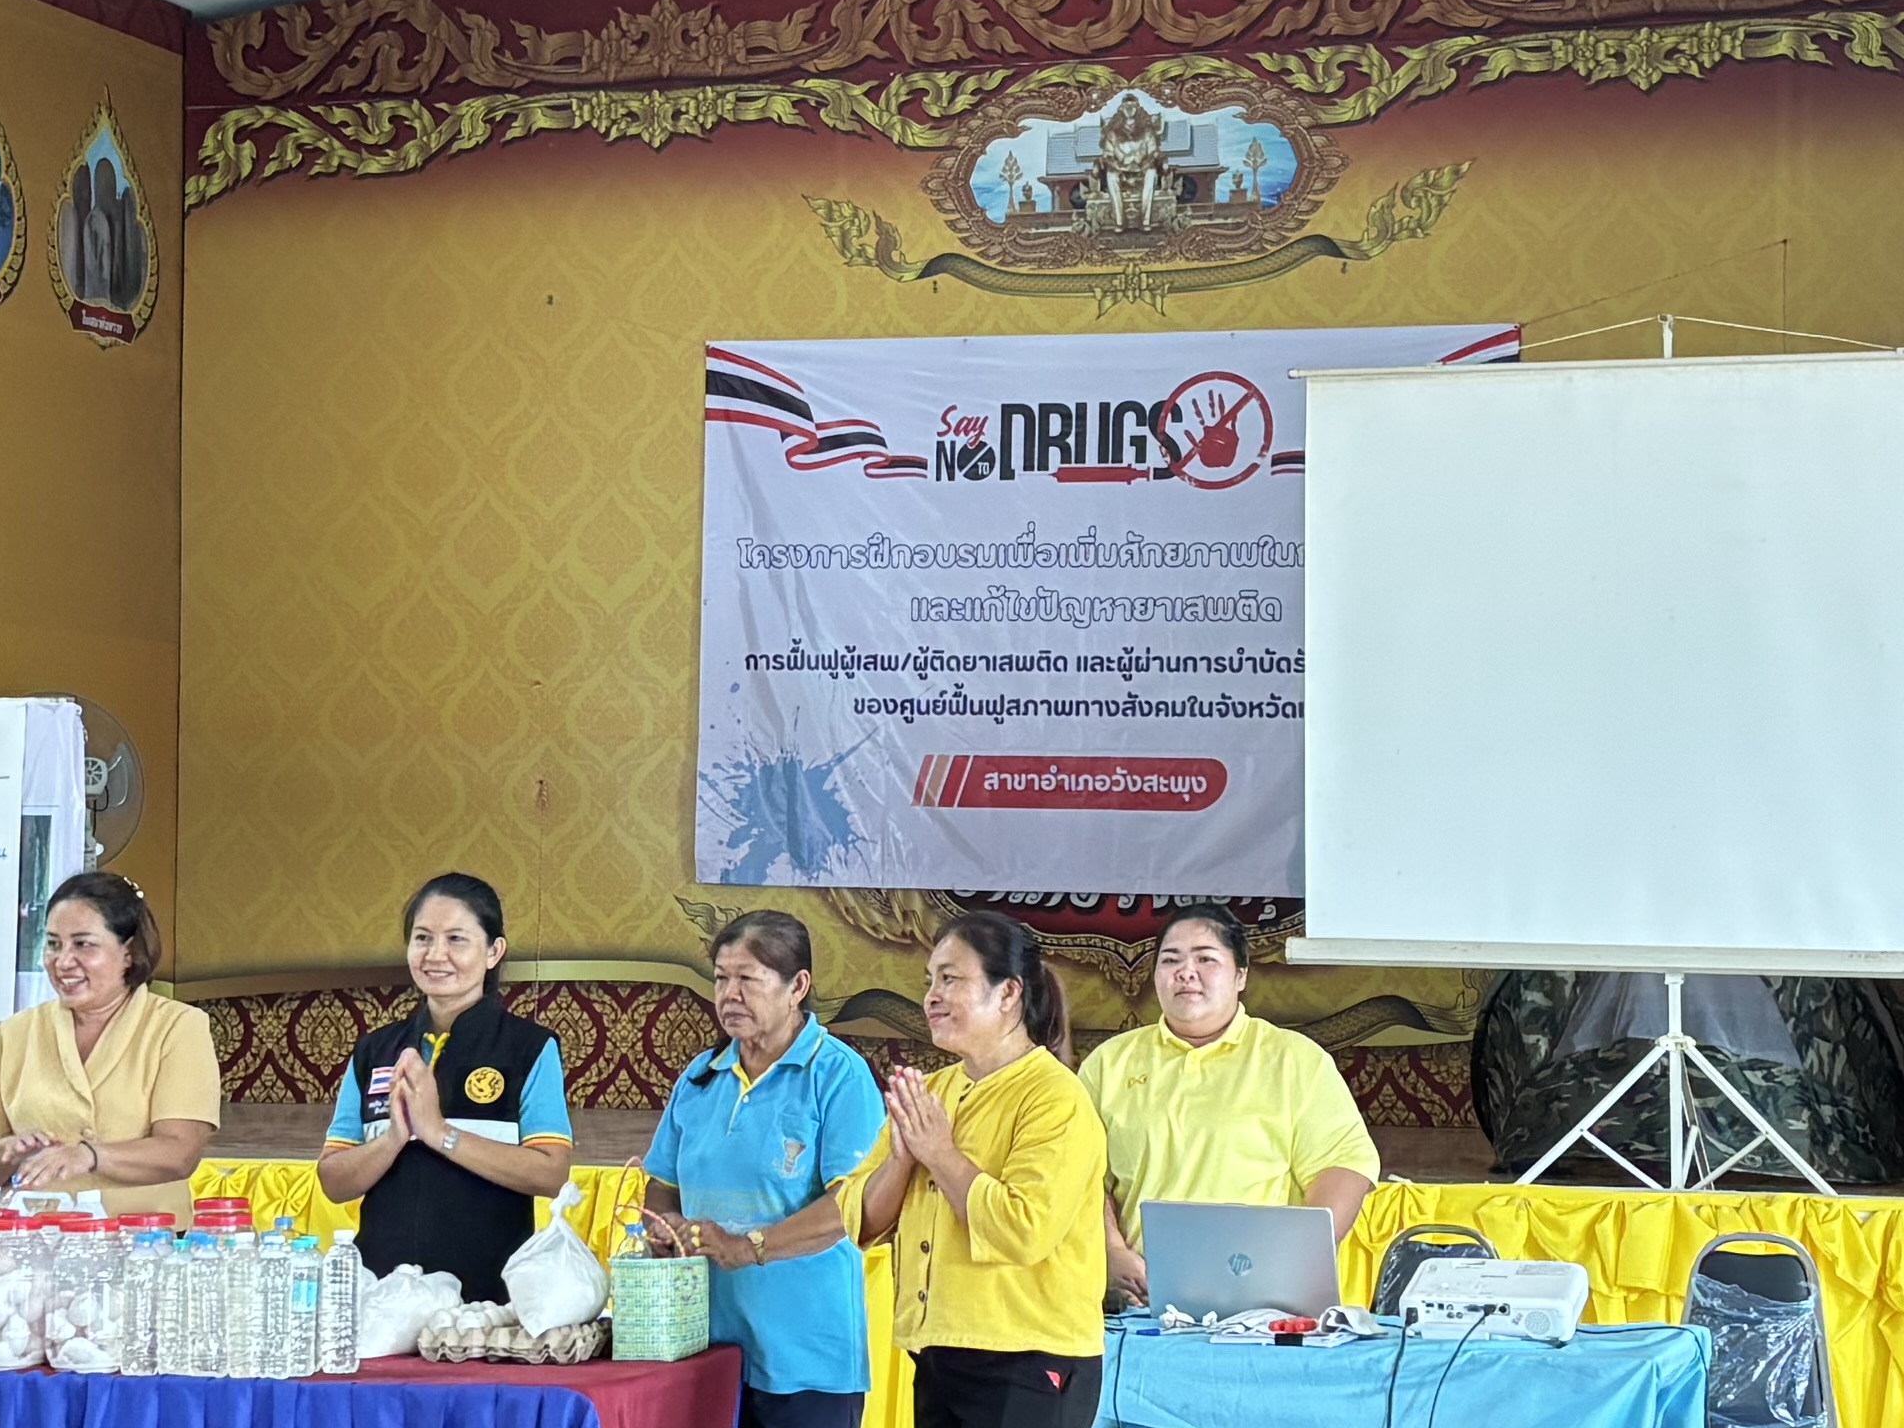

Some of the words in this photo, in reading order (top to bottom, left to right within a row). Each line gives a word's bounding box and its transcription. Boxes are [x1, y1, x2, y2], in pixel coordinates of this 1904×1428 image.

[936, 404, 989, 449] Say
[999, 400, 1183, 481] DRUGS
[910, 585, 1283, 628] และแก้ไขปัญหายาเสพติด
[745, 638, 1068, 680] การฟื้นฟูผู้เสพ/ผู้ติดยาเสพติด
[983, 765, 1207, 802] สาขาอำเภอวังสะพุง
